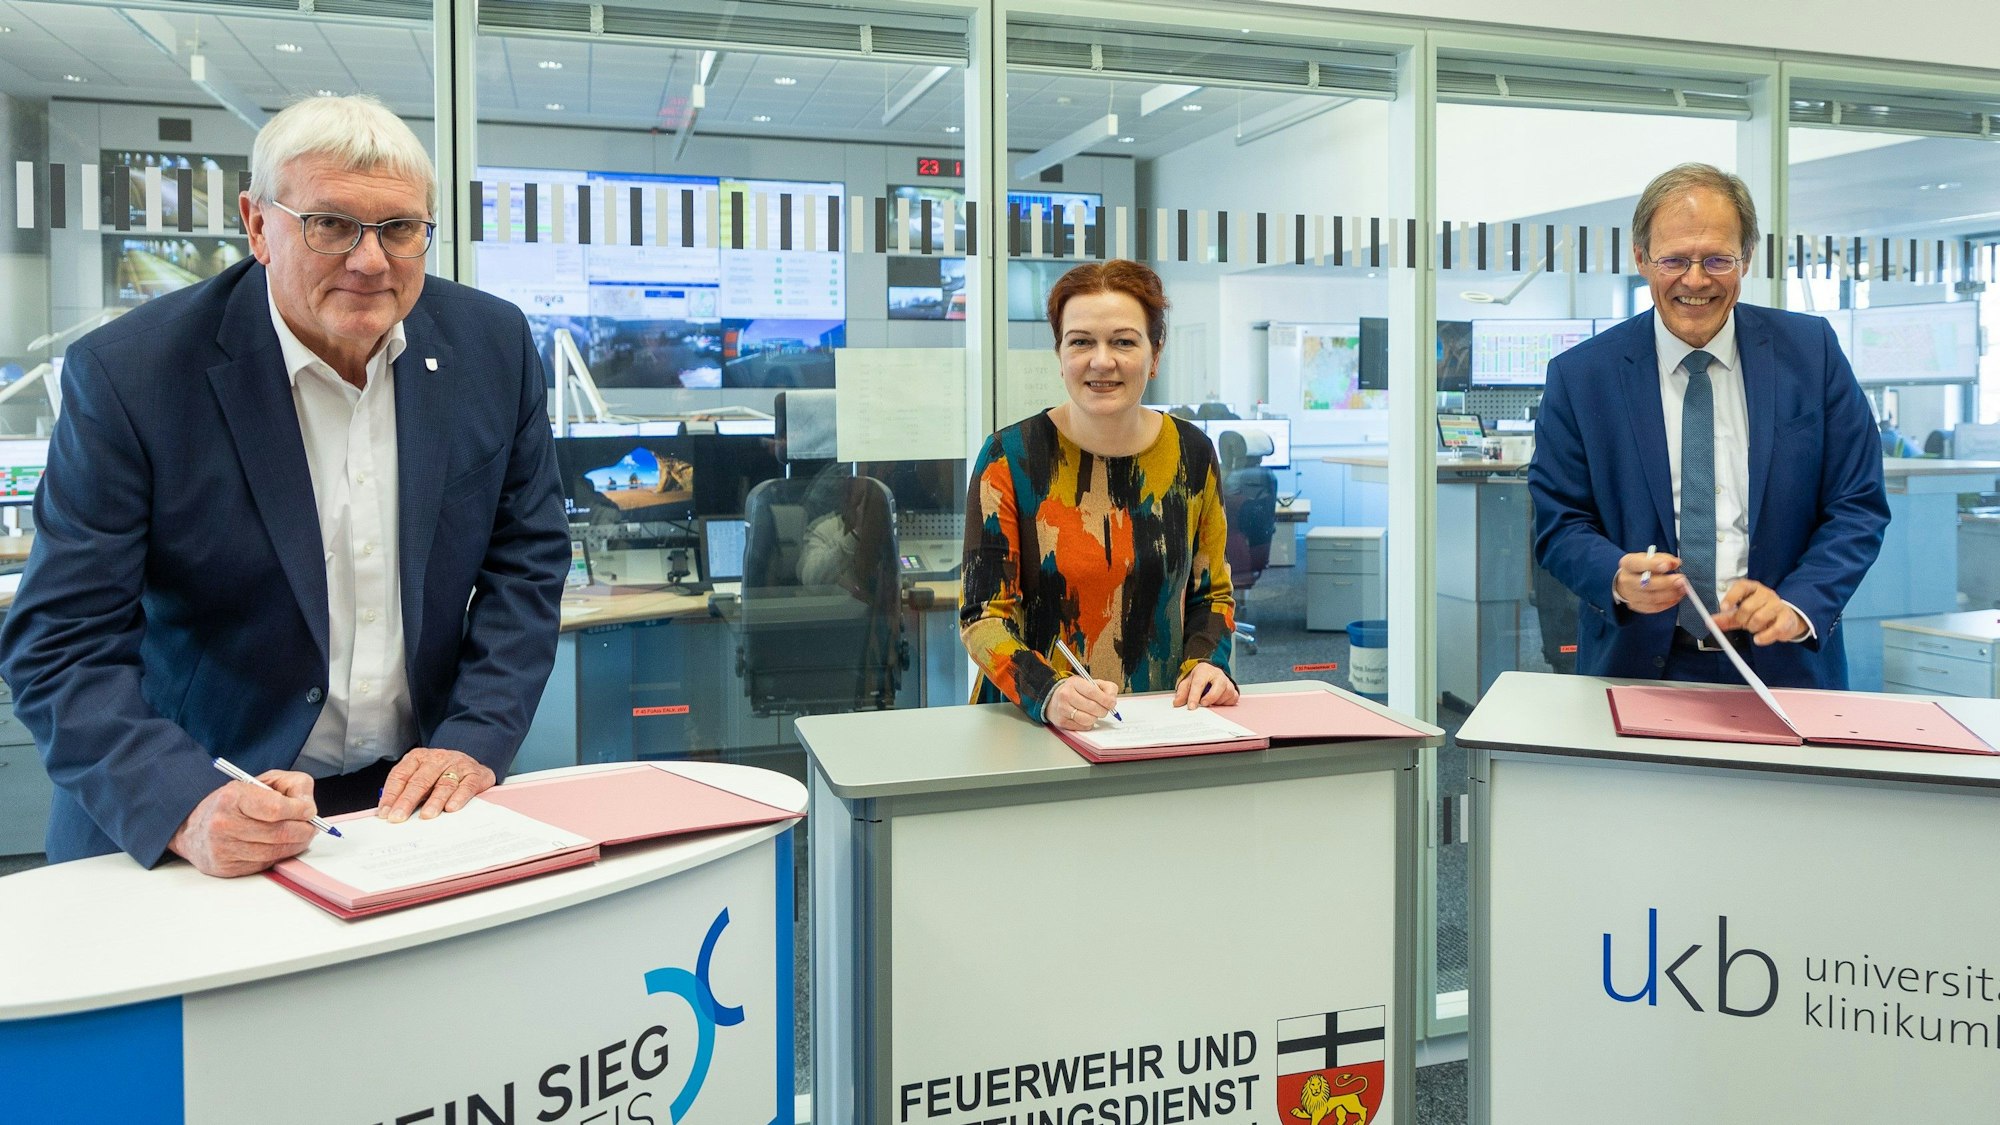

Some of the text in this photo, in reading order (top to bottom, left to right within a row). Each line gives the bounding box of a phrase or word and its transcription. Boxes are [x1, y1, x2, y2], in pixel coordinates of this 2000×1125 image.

[919, 159, 939, 176] 23
[1602, 907, 1780, 1019] ukb
[1805, 954, 2000, 1002] universit
[1805, 992, 2000, 1049] klinikum
[536, 1024, 669, 1123] SIEG
[900, 1029, 1258, 1123] FEUERWEHR UND
